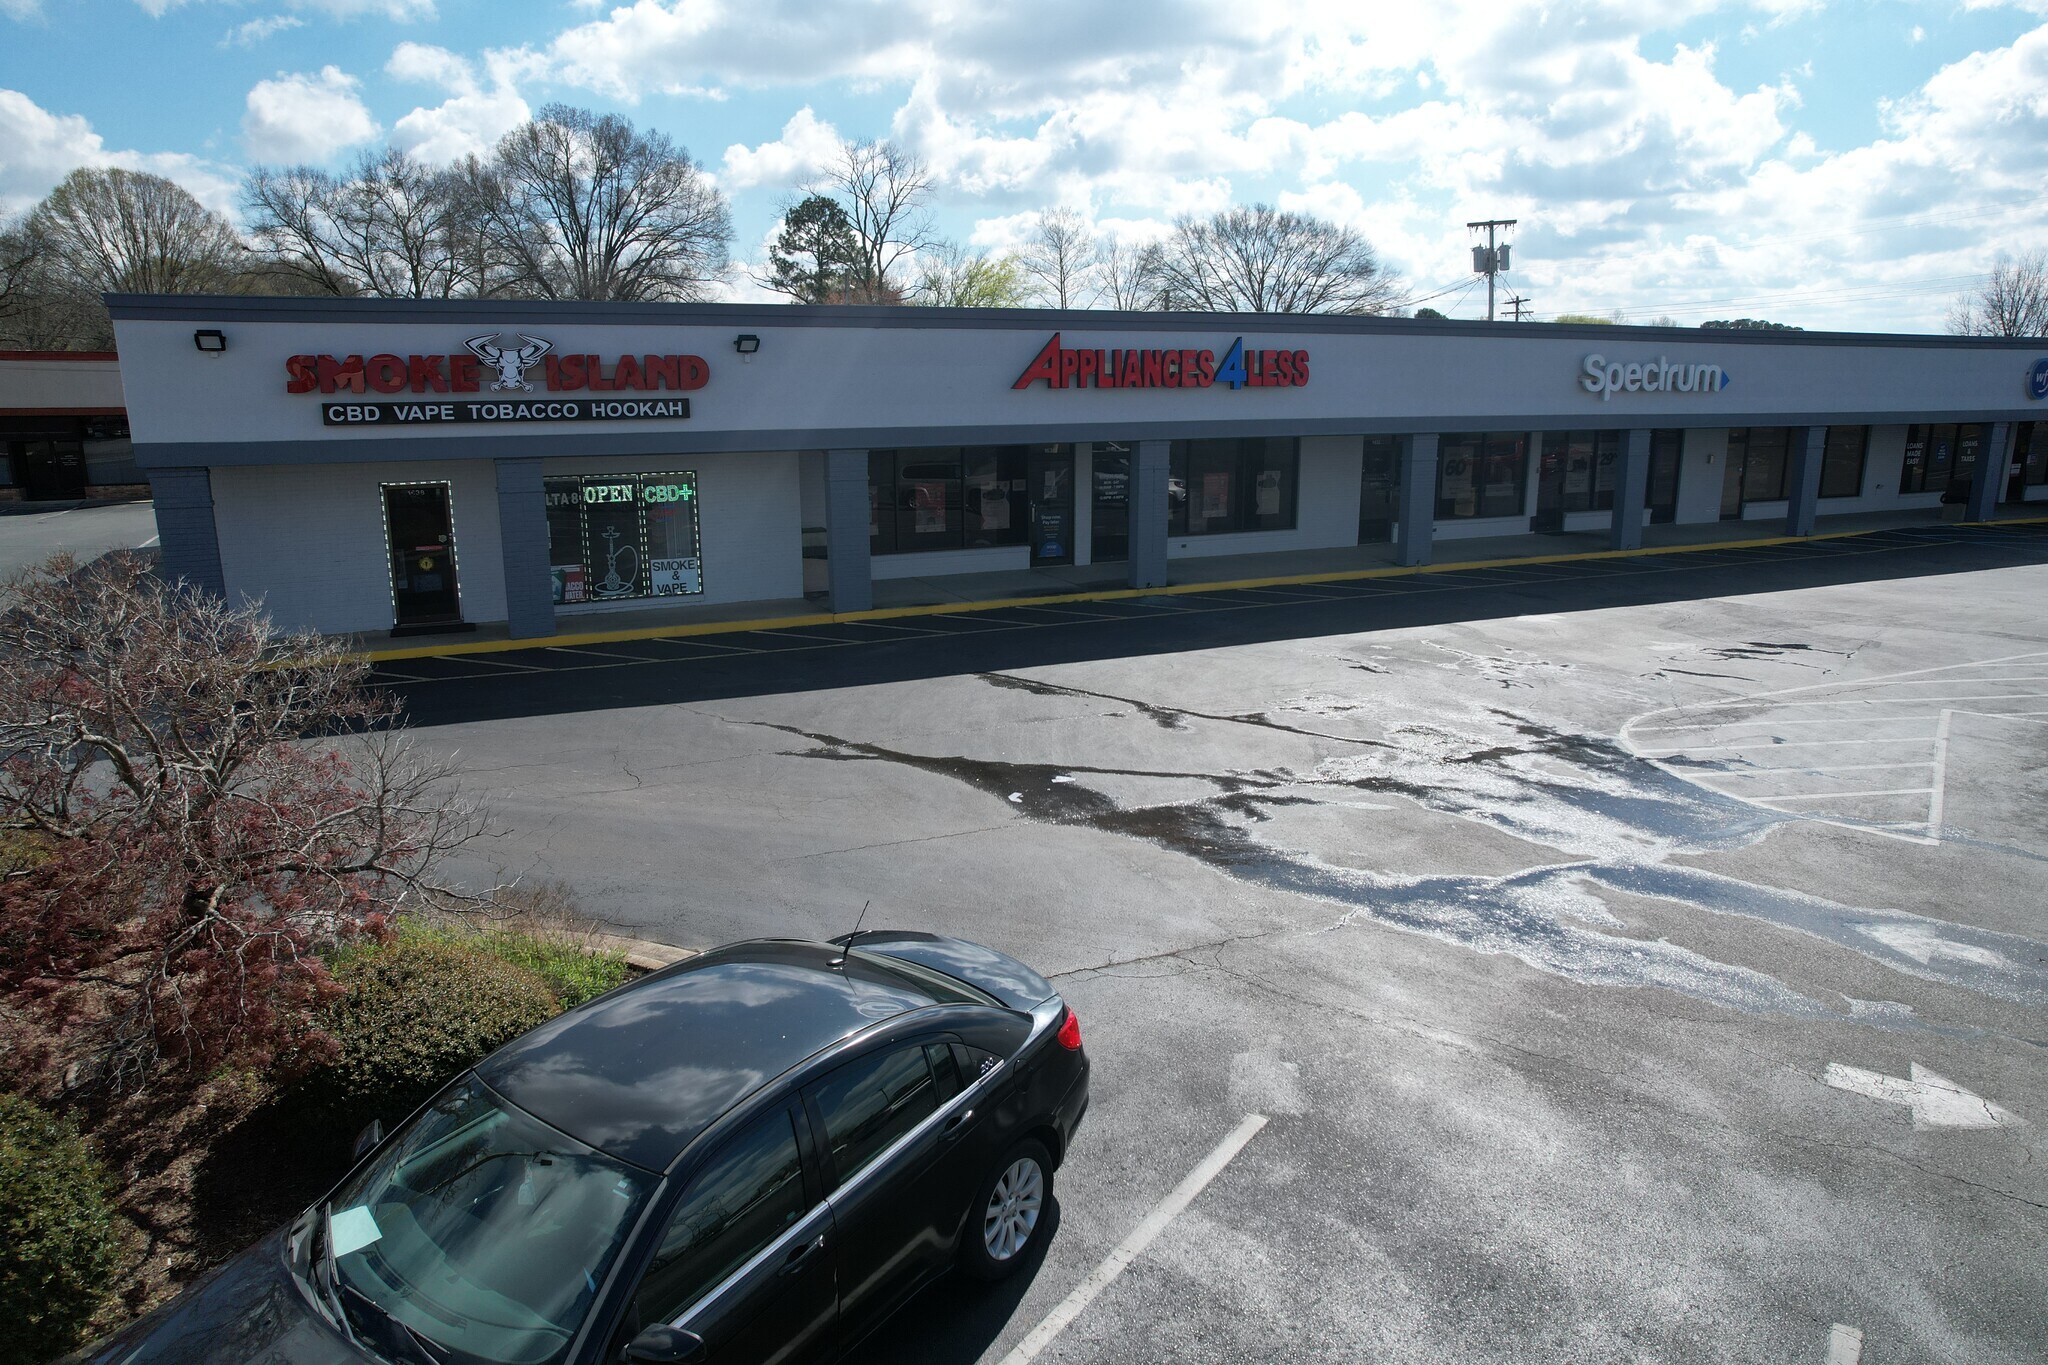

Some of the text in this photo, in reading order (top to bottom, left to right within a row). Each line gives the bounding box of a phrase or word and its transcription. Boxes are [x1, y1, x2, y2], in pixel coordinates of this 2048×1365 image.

[1011, 332, 1310, 390] APPLIANCES 4 LESS
[286, 353, 711, 394] SMOKE ISLAND
[1582, 353, 1722, 401] Spectrum
[328, 401, 684, 422] CBD VAPE TOBACCO HOOKAH
[585, 485, 633, 504] OPEN
[652, 560, 695, 572] SMOKE
[671, 571, 680, 581] &
[656, 583, 688, 595] VAPE
